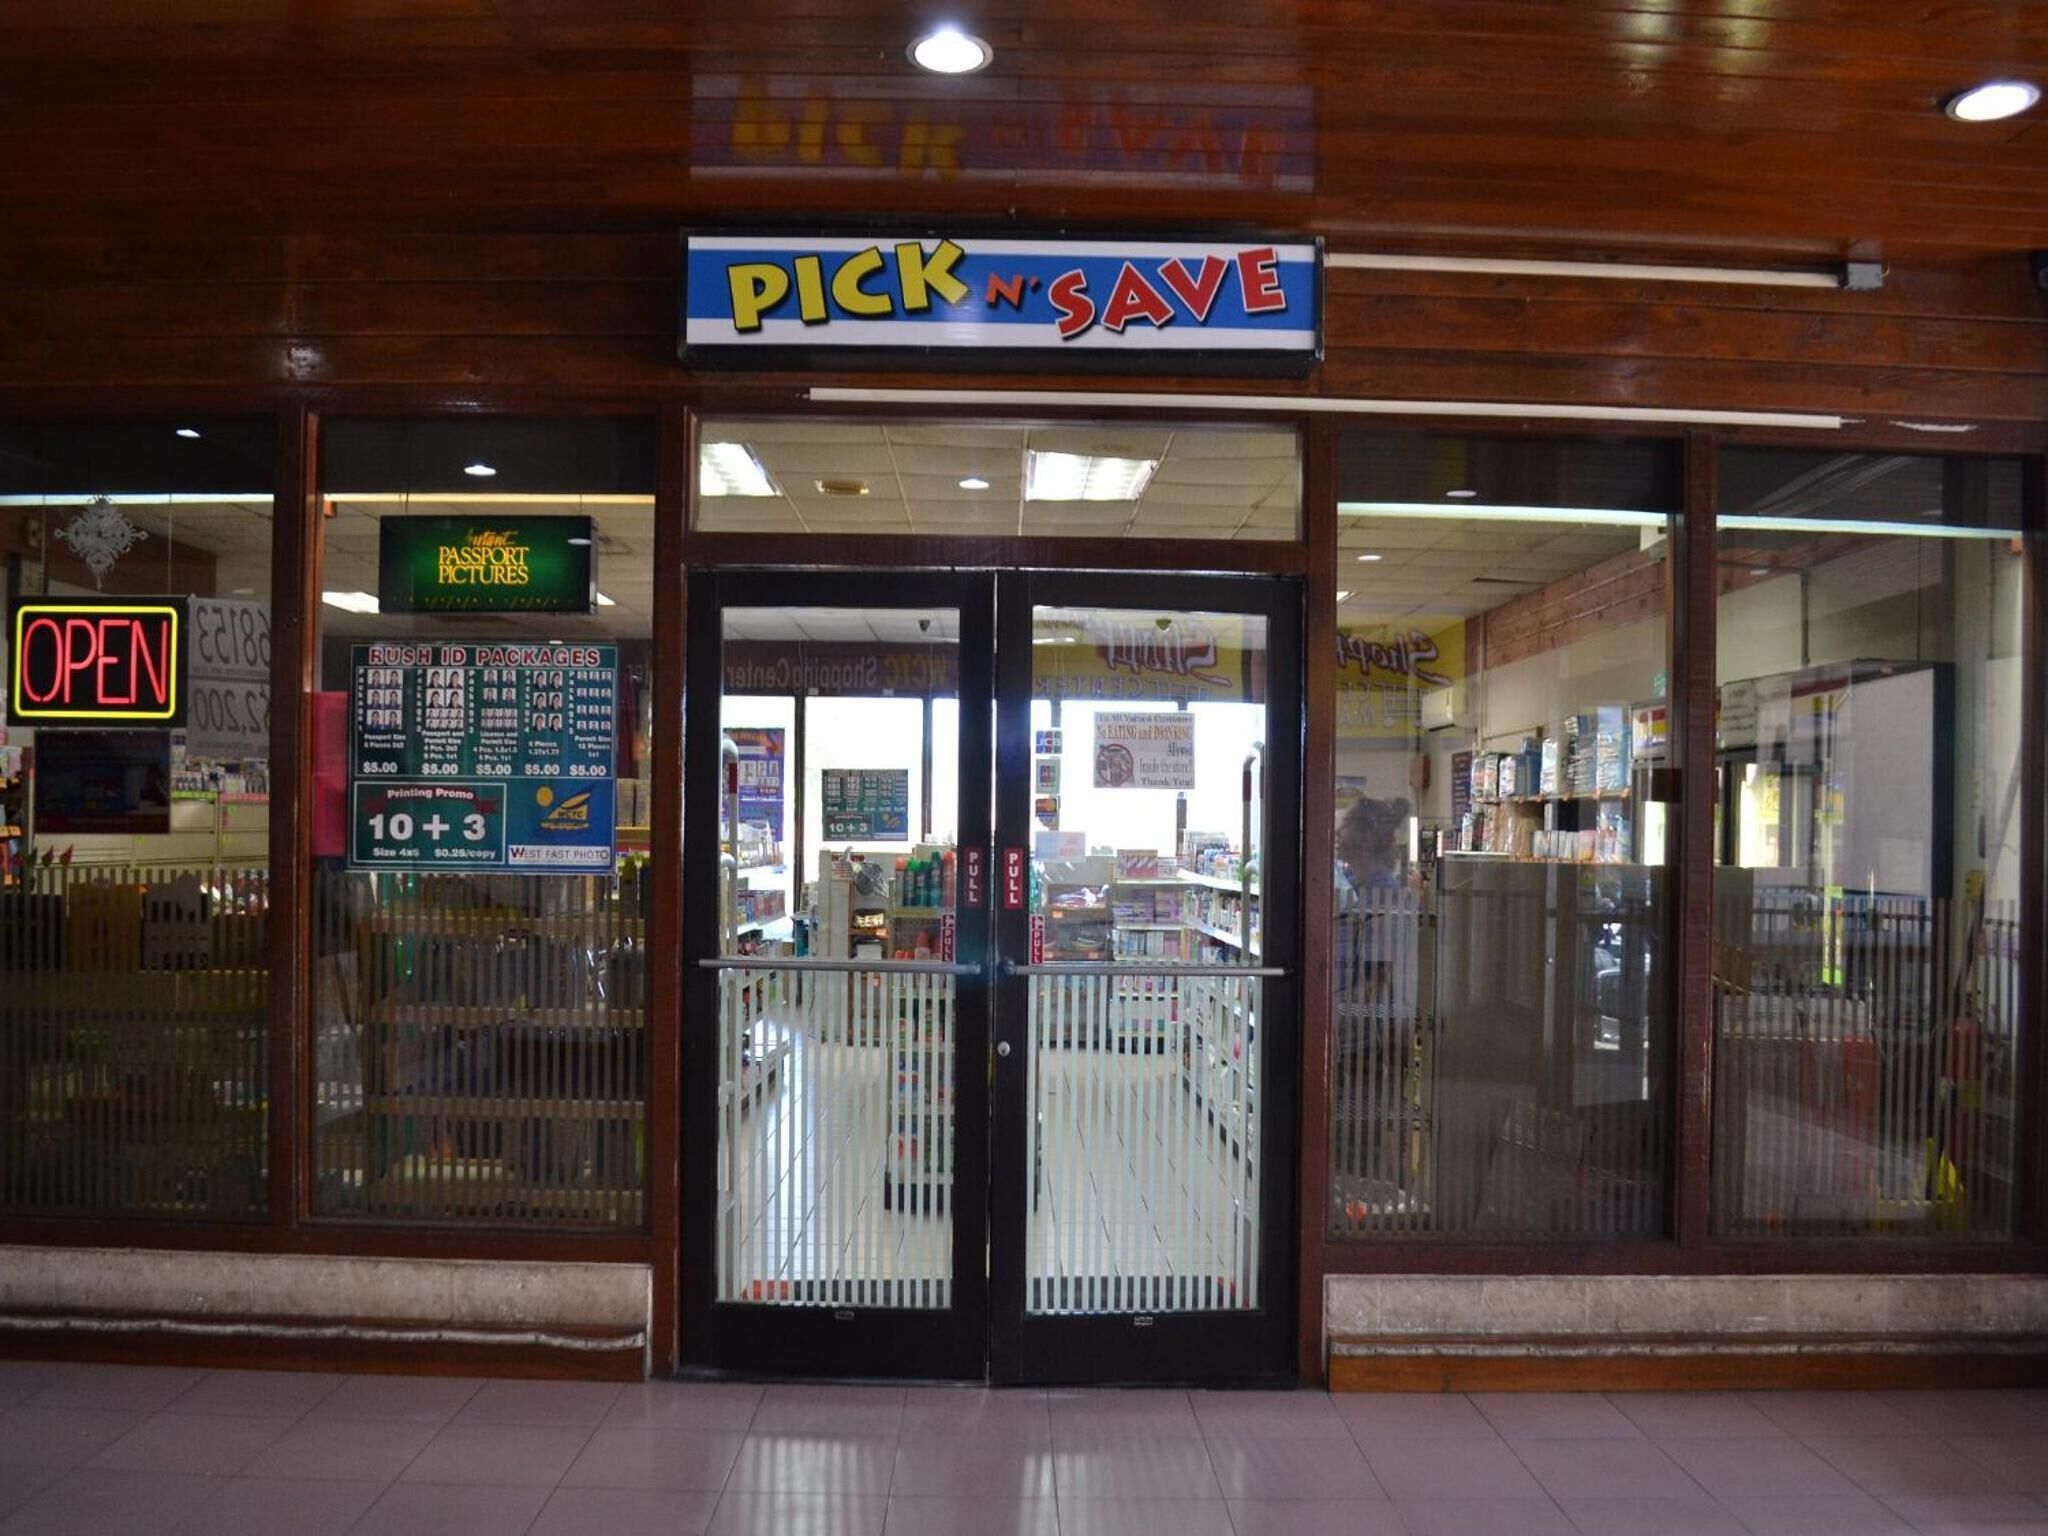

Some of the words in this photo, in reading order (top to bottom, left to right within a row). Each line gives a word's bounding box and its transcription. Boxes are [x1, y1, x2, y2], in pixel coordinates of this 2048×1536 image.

[726, 239, 970, 332] PICK
[1048, 246, 1287, 341] SAVE
[438, 546, 530, 565] PASSPORT
[438, 565, 530, 585] PICTURES
[22, 618, 169, 704] OPEN
[368, 646, 433, 666] RUSH
[440, 647, 467, 666] ID
[475, 647, 601, 667] PACKAGES
[1106, 725, 1137, 739] EATING
[363, 761, 398, 774] $5.00
[421, 763, 459, 775] $5.00
[475, 764, 512, 775] $5.00
[524, 764, 560, 775] $5.00
[569, 765, 607, 776] $5.00
[387, 788, 432, 799] Printing
[435, 788, 474, 799] Promo
[368, 813, 414, 840] 10
[462, 813, 486, 841] 3
[373, 848, 397, 857] Size
[545, 849, 570, 859] FAST
[574, 849, 609, 860] PHOTO
[968, 851, 979, 903] PULL
[1008, 852, 1019, 905] PULL
[944, 930, 952, 962] PULL
[1033, 931, 1041, 965] PULL
